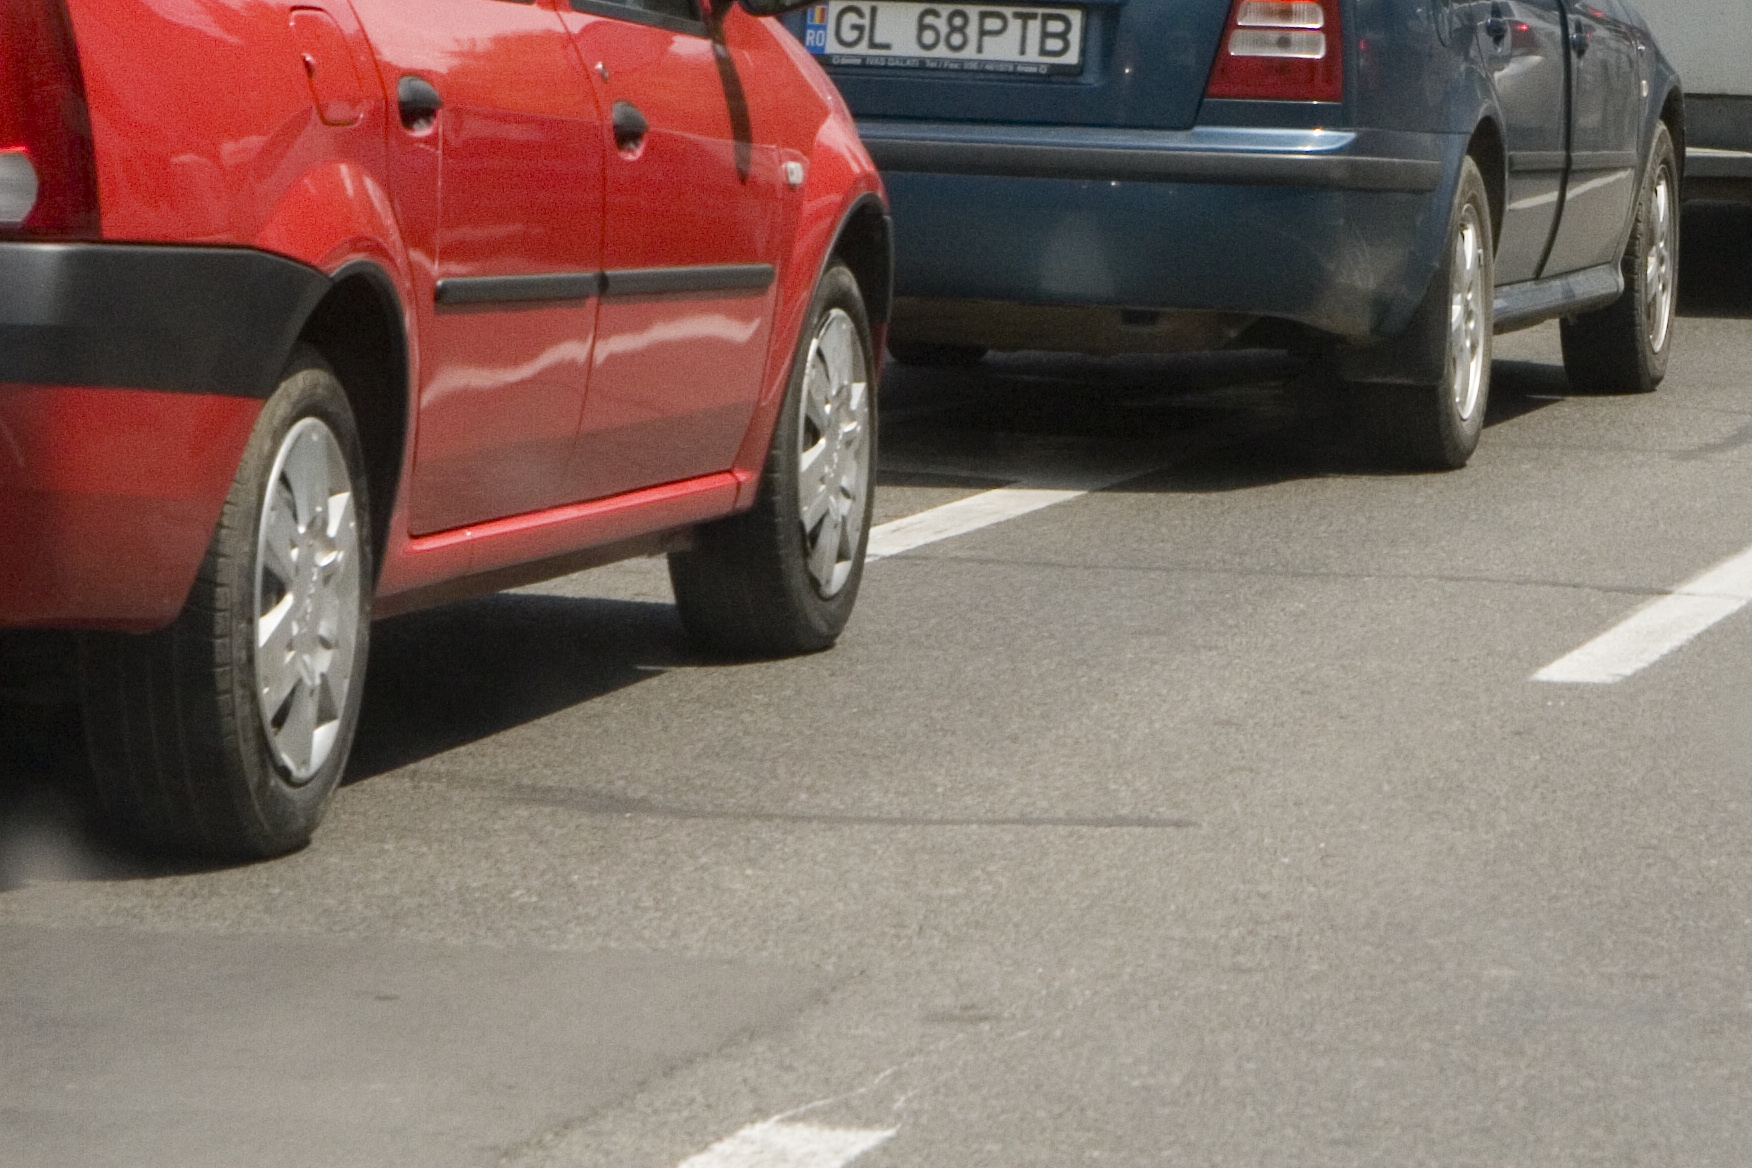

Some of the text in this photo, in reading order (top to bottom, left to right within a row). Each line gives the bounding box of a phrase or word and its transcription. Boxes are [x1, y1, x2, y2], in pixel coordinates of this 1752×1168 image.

[806, 29, 825, 48] RO
[834, 4, 1073, 58] GL 68PTB
